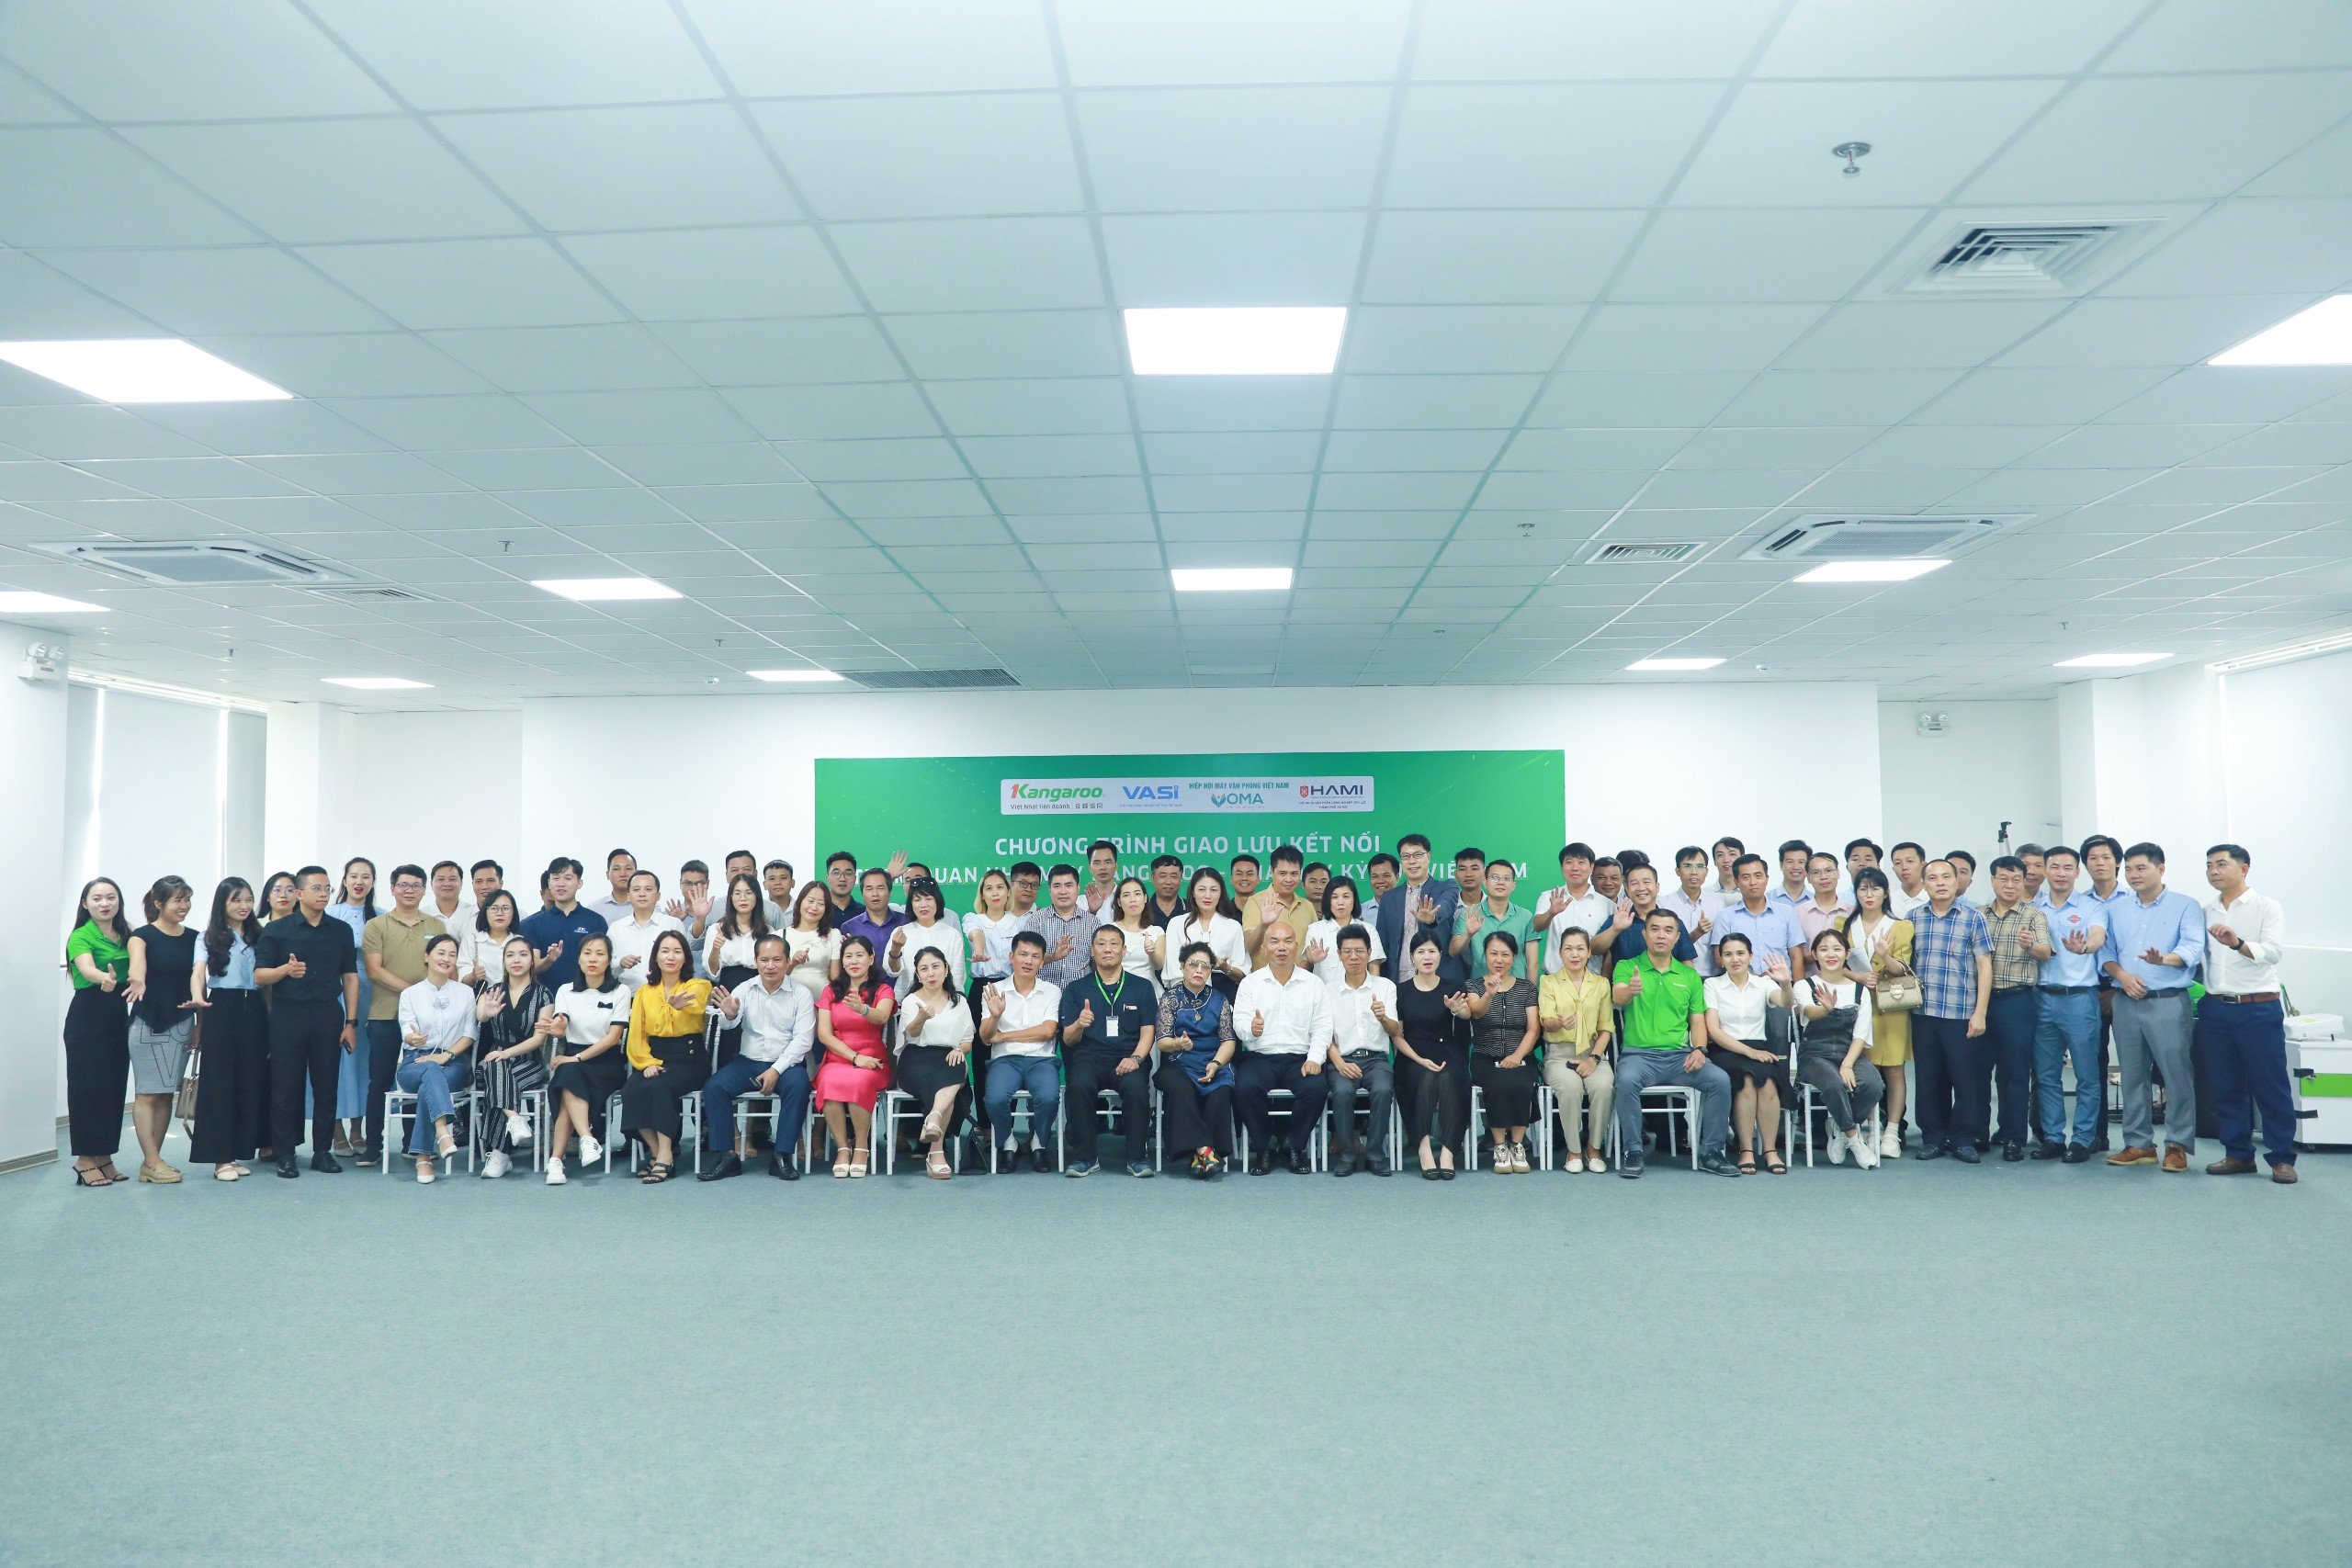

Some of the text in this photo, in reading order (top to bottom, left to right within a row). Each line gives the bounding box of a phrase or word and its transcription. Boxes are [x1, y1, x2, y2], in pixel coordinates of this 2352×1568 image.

[1189, 782, 1203, 791] HIỆP
[1262, 781, 1274, 791] VIỆT
[1310, 784, 1363, 795] HAMI
[995, 837, 1089, 856] CHƯƠNG
[1173, 836, 1229, 854] GIAO
[1237, 836, 1282, 853] LƯU
[1289, 830, 1333, 853] KẾT
[1340, 830, 1381, 853] NỐI
[929, 866, 978, 884] UAN
